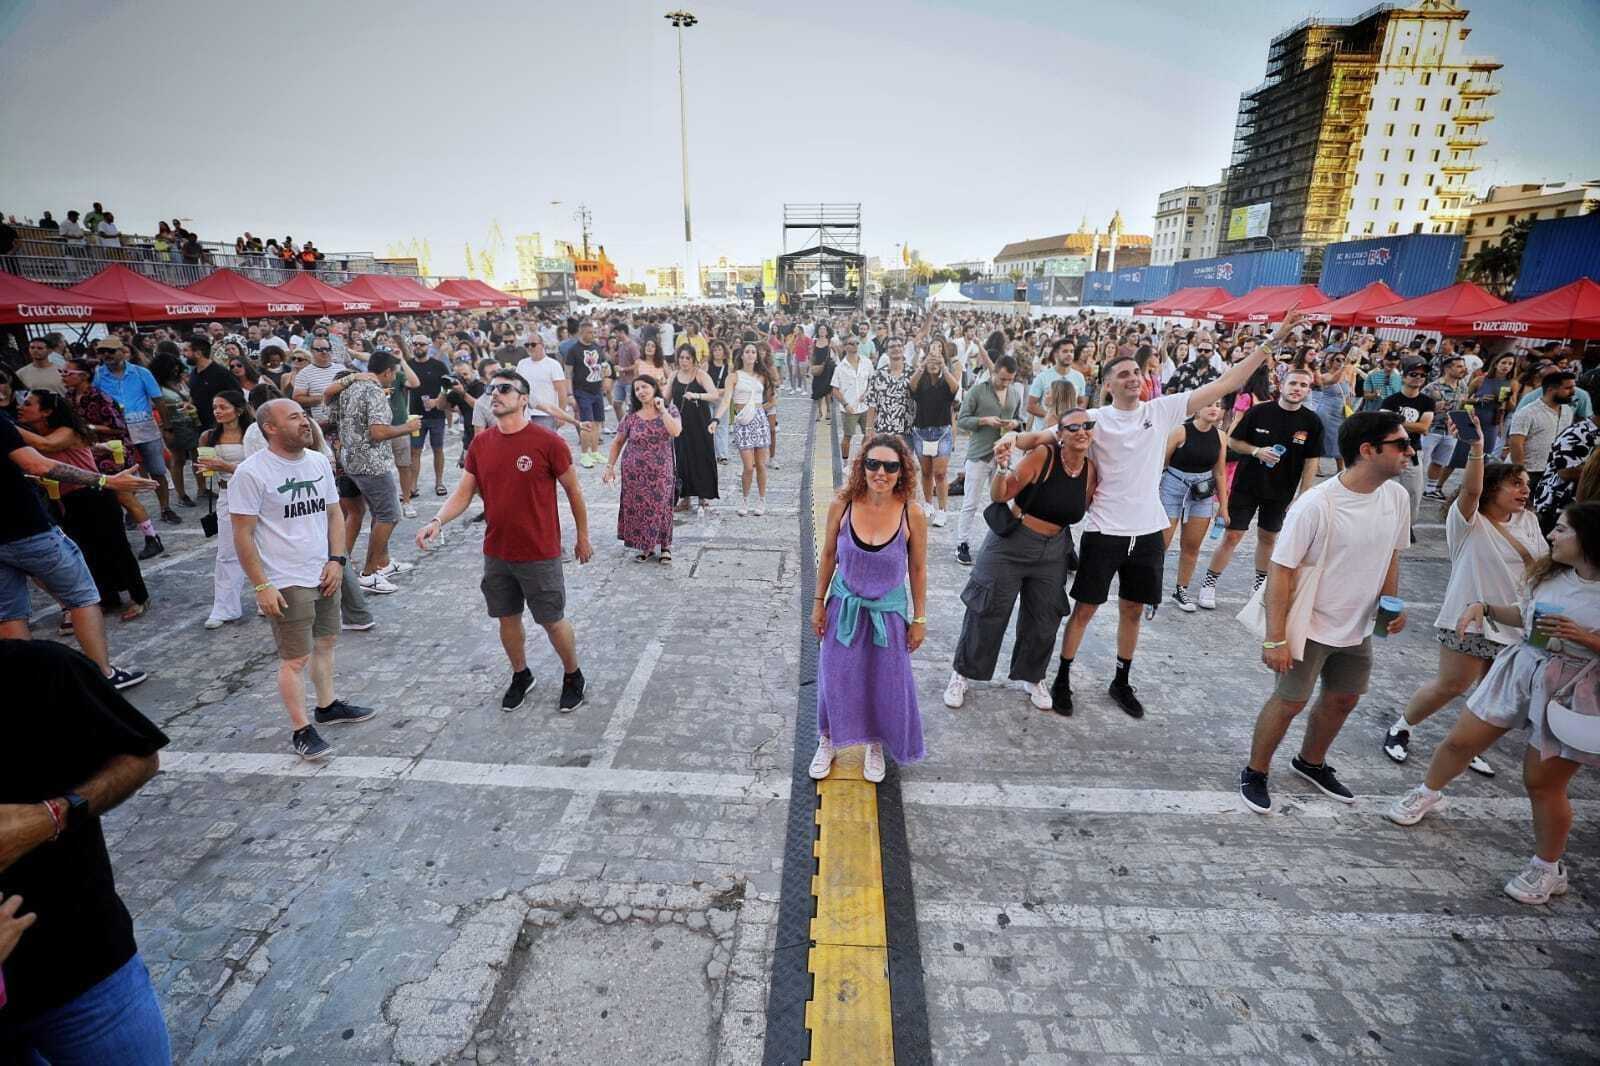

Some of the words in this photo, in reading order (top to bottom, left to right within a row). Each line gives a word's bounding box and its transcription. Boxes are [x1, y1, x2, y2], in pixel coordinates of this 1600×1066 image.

[18, 303, 93, 318] Cruzcampo
[165, 303, 217, 316] Cruzcampo
[1375, 315, 1417, 326] Cruzcampo
[1472, 320, 1530, 333] Cruzcampo
